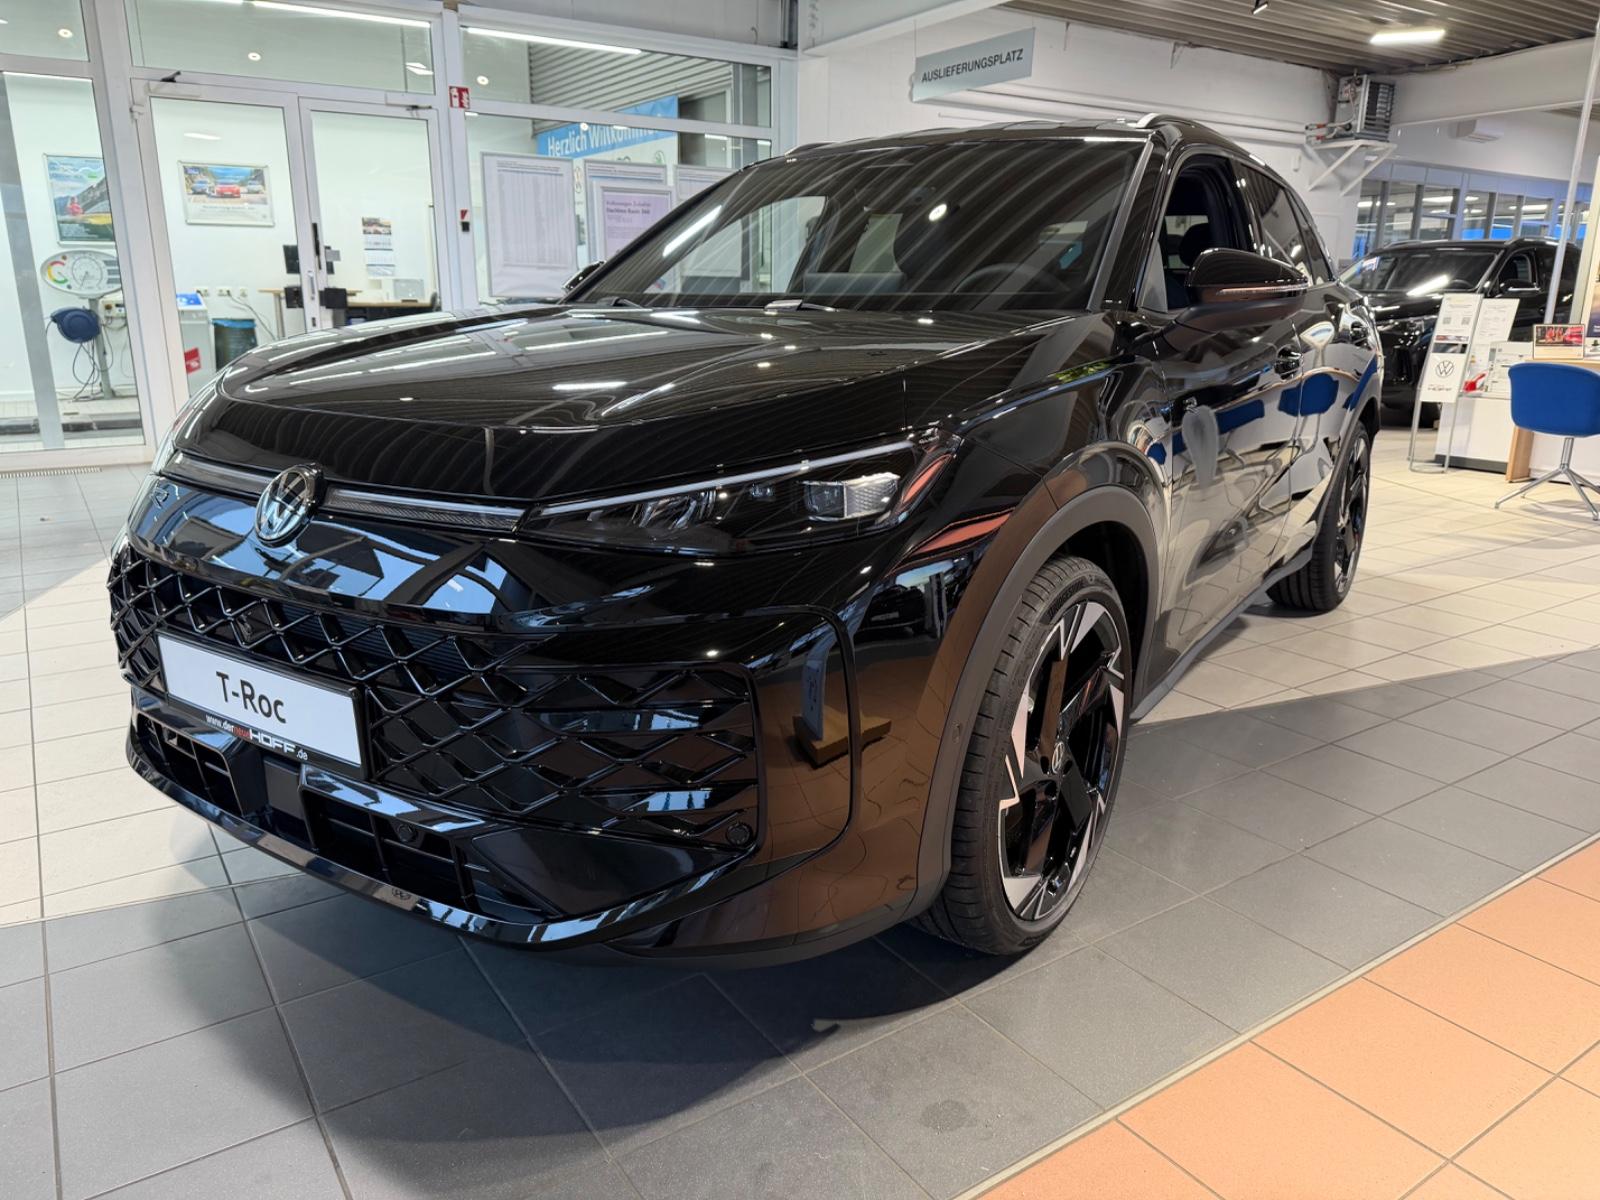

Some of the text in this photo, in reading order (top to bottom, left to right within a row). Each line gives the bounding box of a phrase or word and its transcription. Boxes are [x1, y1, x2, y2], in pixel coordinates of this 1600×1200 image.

[921, 48, 1023, 83] AUSLIEFERUNGSPLATZ
[548, 125, 655, 157] Herzlich Willkomm
[216, 671, 287, 724] T-Roc
